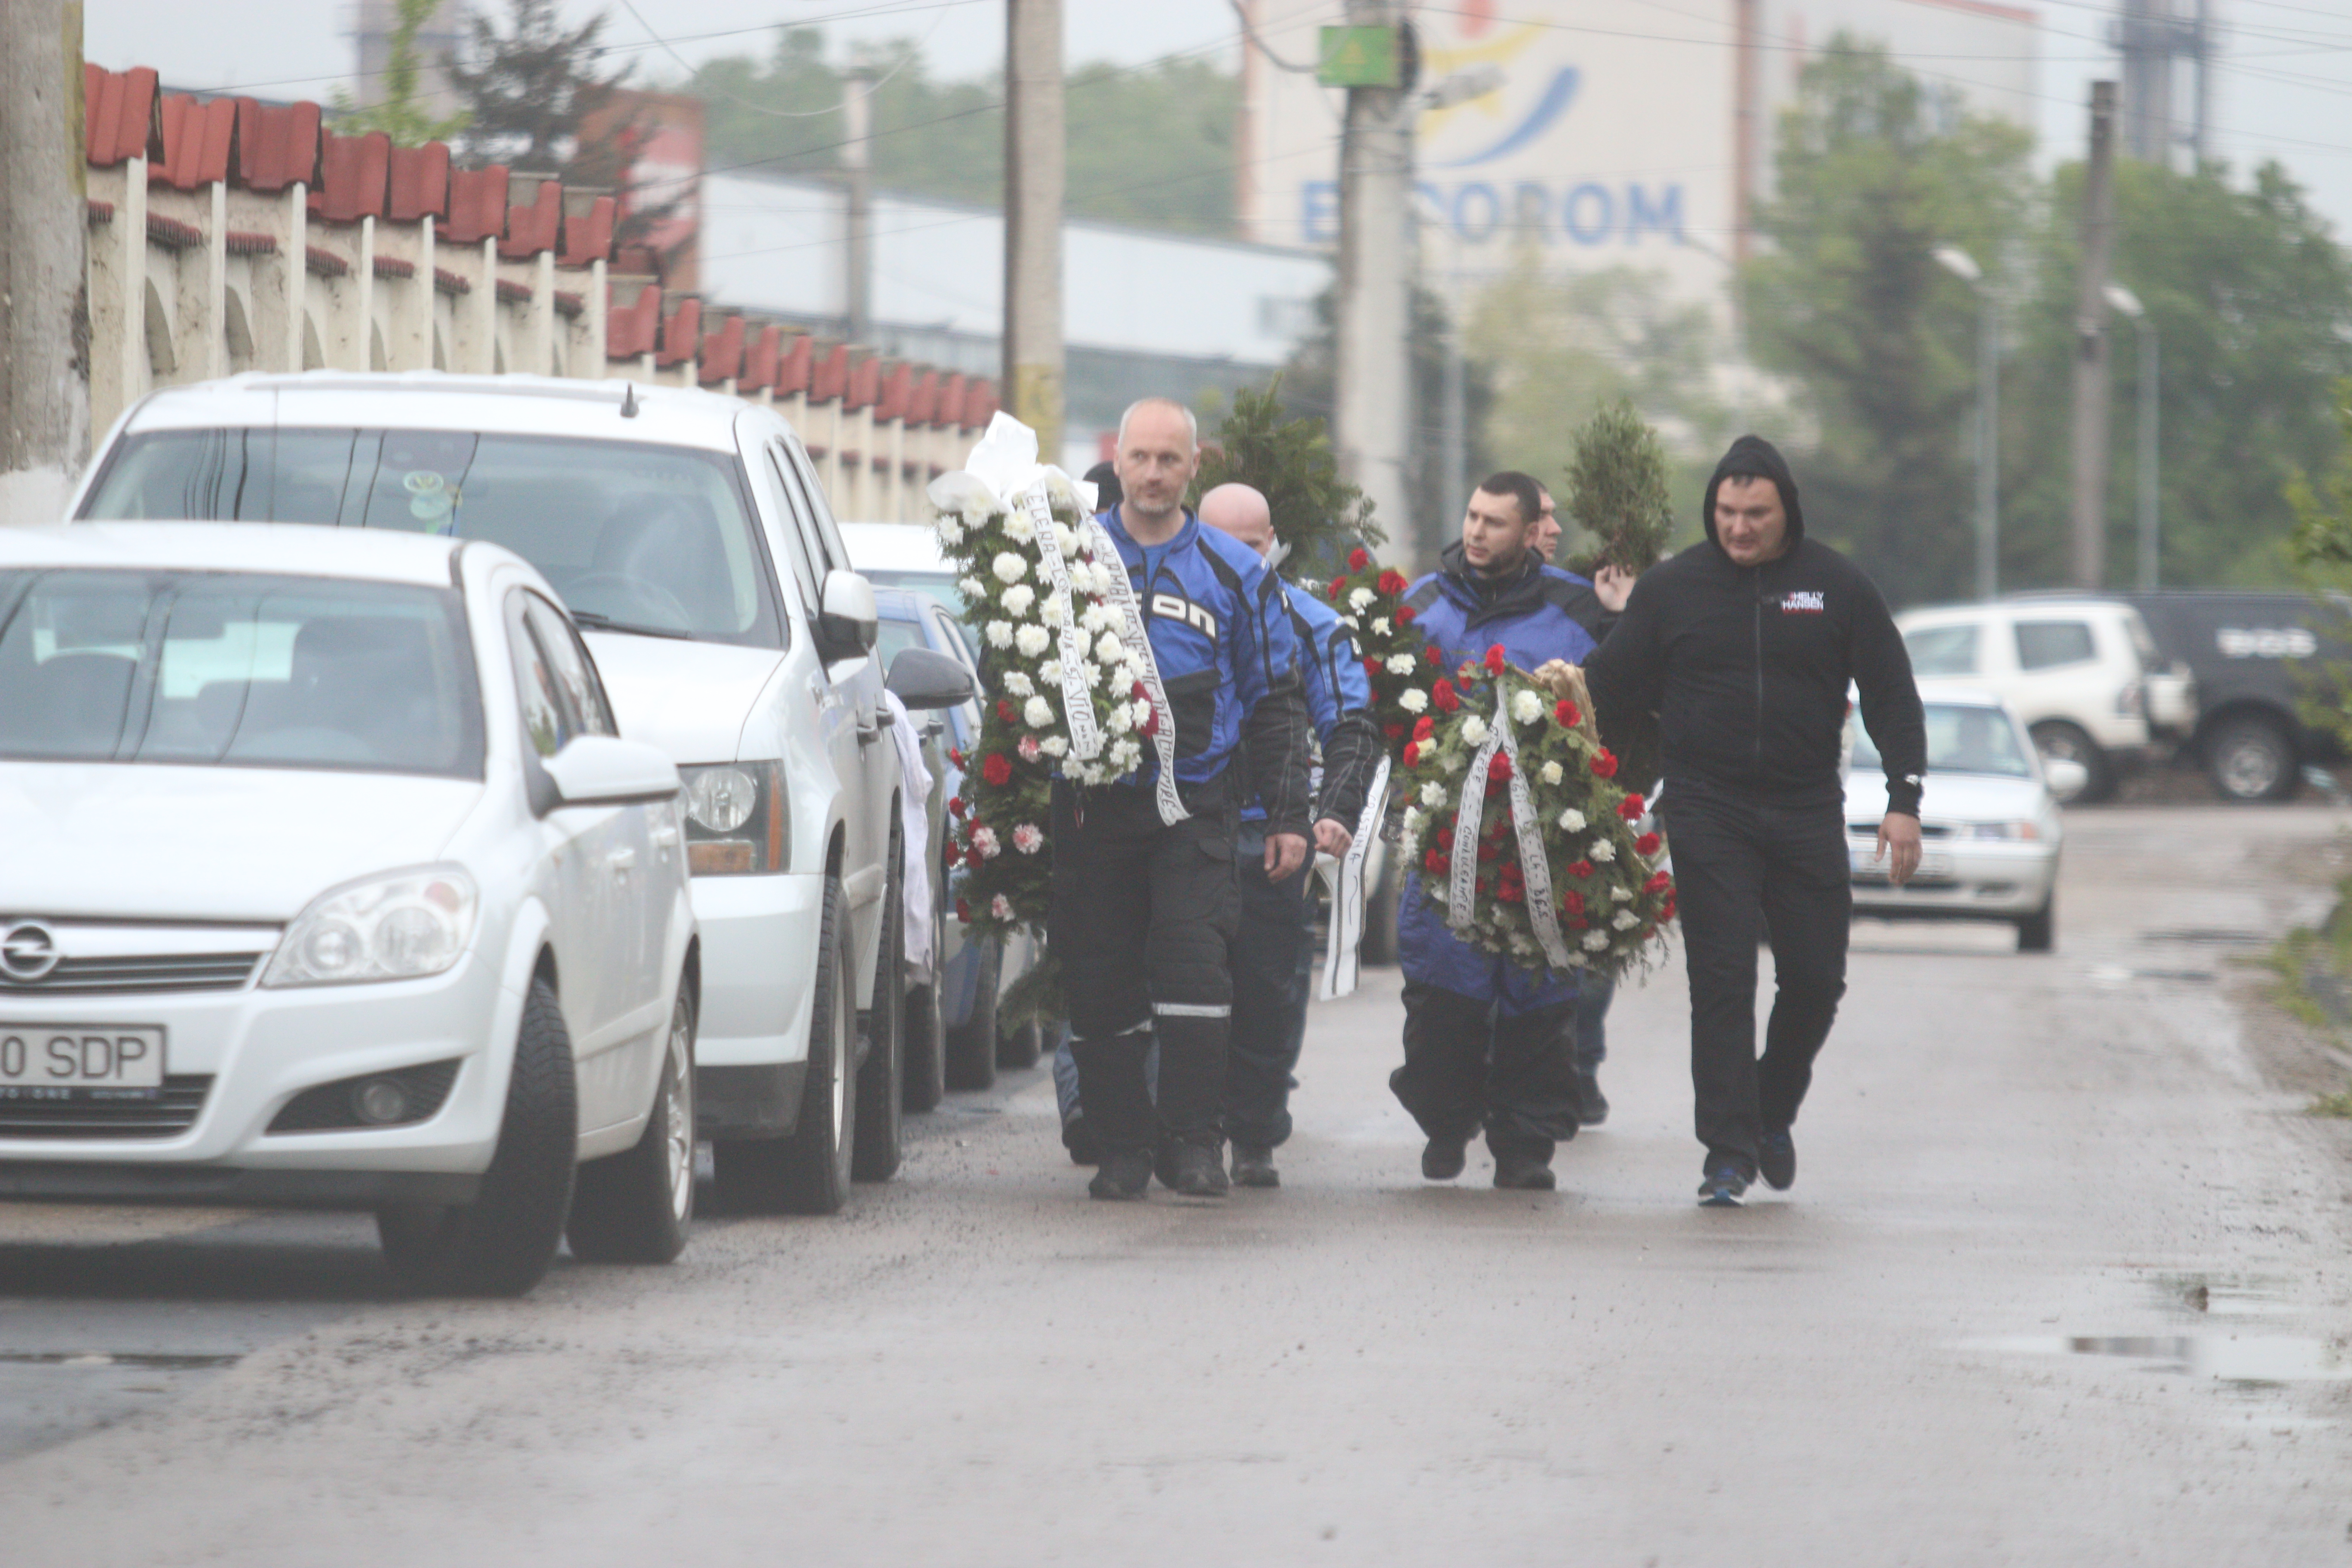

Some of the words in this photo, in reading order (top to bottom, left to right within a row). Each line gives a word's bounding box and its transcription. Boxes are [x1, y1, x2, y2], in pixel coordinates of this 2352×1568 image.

[1794, 591, 1824, 601] HELLY
[1782, 600, 1824, 611] HANSEN
[46, 1036, 146, 1080] SDP
